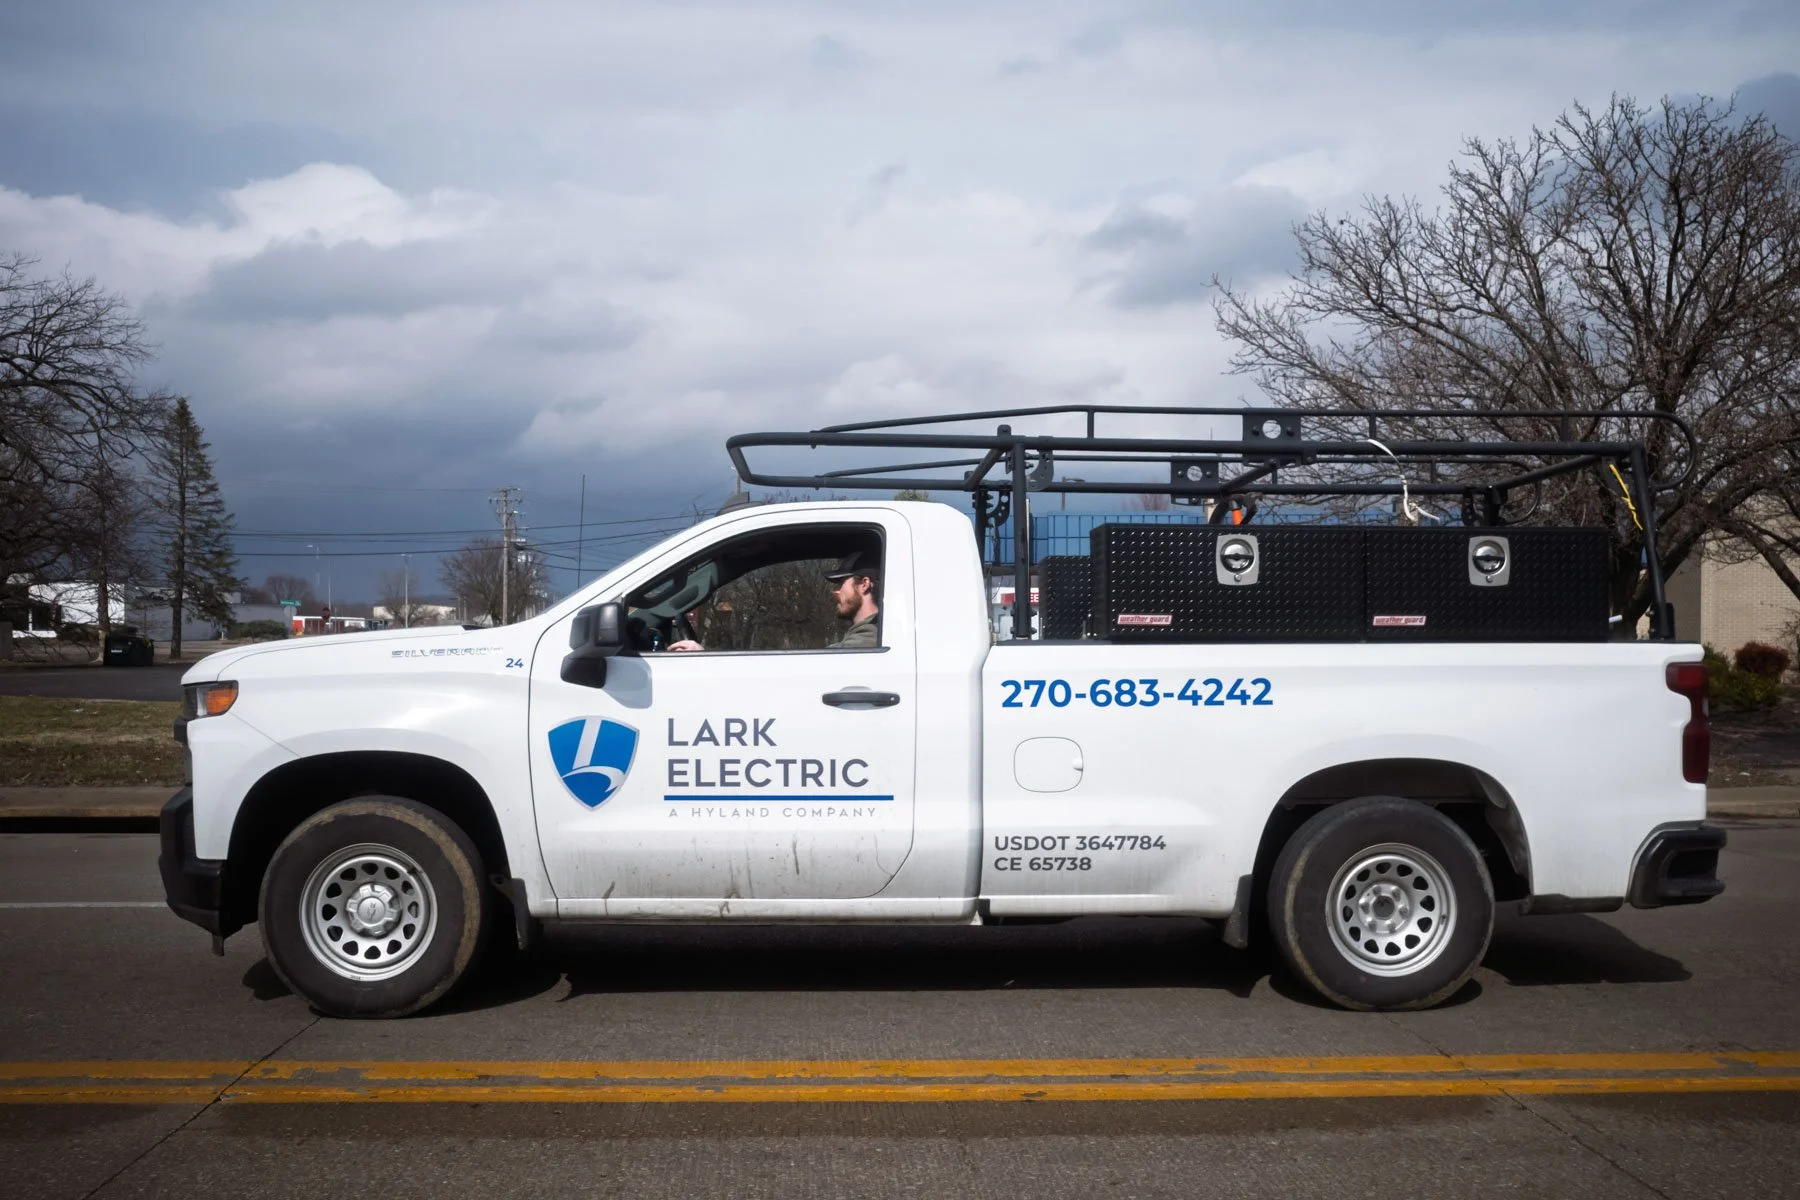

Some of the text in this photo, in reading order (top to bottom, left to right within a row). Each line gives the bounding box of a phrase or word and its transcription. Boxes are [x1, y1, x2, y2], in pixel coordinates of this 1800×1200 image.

[505, 657, 525, 669] 24
[1000, 677, 1274, 708] 270-683-4242
[667, 718, 778, 747] LARK
[667, 758, 870, 788] ELECTRIC
[668, 807, 877, 818] A HYLAND COMPANY
[994, 834, 1167, 851] USDOT 3647784
[993, 856, 1092, 872] CE 65738
